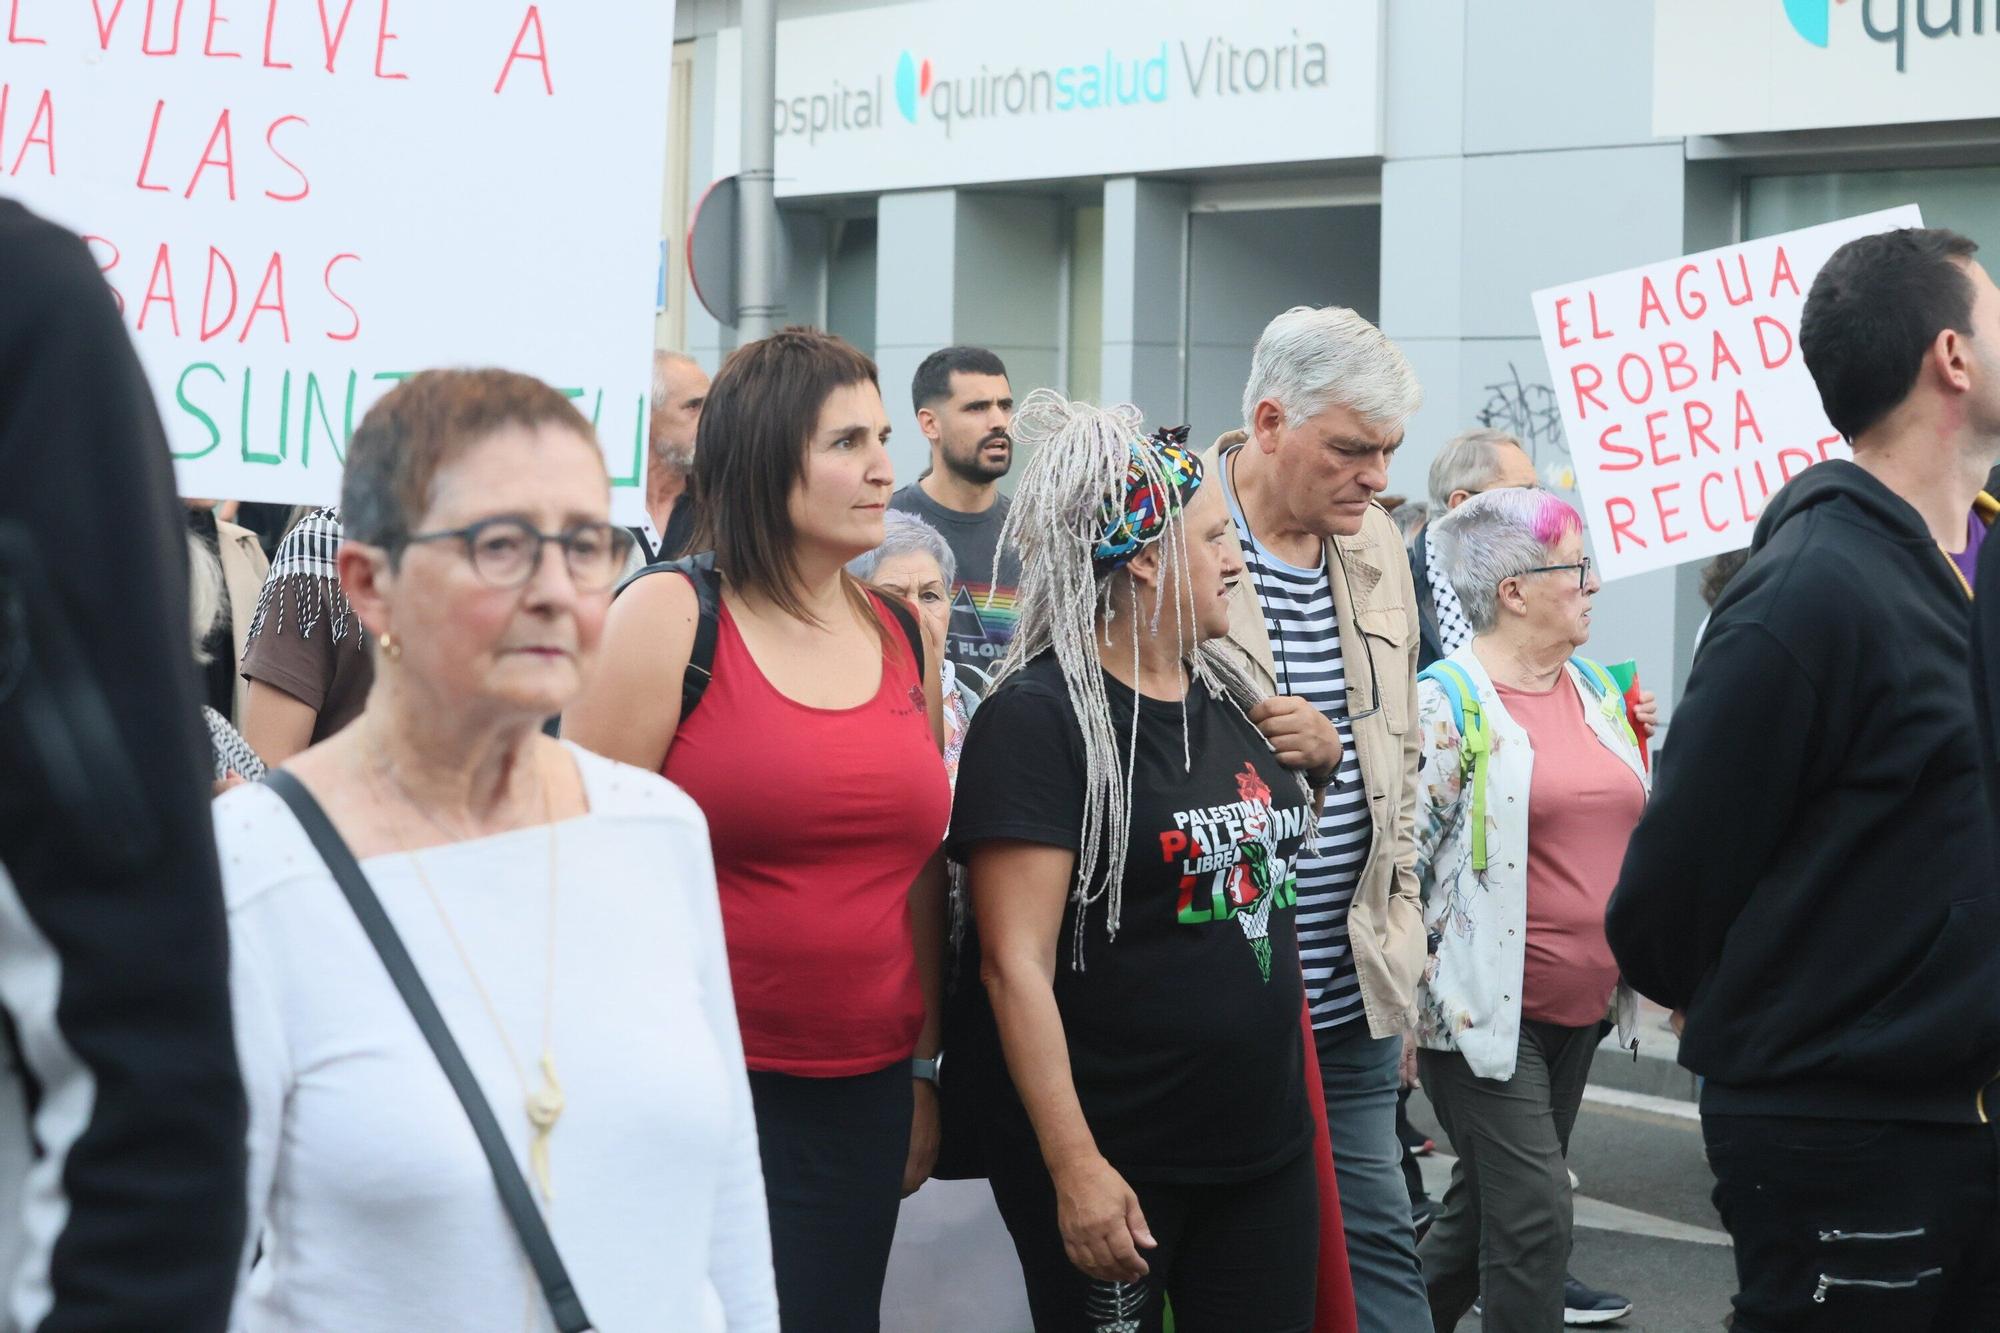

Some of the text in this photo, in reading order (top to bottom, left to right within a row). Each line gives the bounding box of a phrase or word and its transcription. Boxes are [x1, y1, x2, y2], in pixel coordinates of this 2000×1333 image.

[494, 4, 554, 96] A
[1179, 27, 1328, 98] Vitoria
[0, 83, 310, 201] A LAS
[1555, 245, 1801, 348] EL AGUA
[1570, 315, 1793, 419] ROBAD
[1599, 388, 1764, 471] SERA
[1173, 798, 1266, 830] PALESTINA
[1183, 850, 1233, 876] LIBRE
